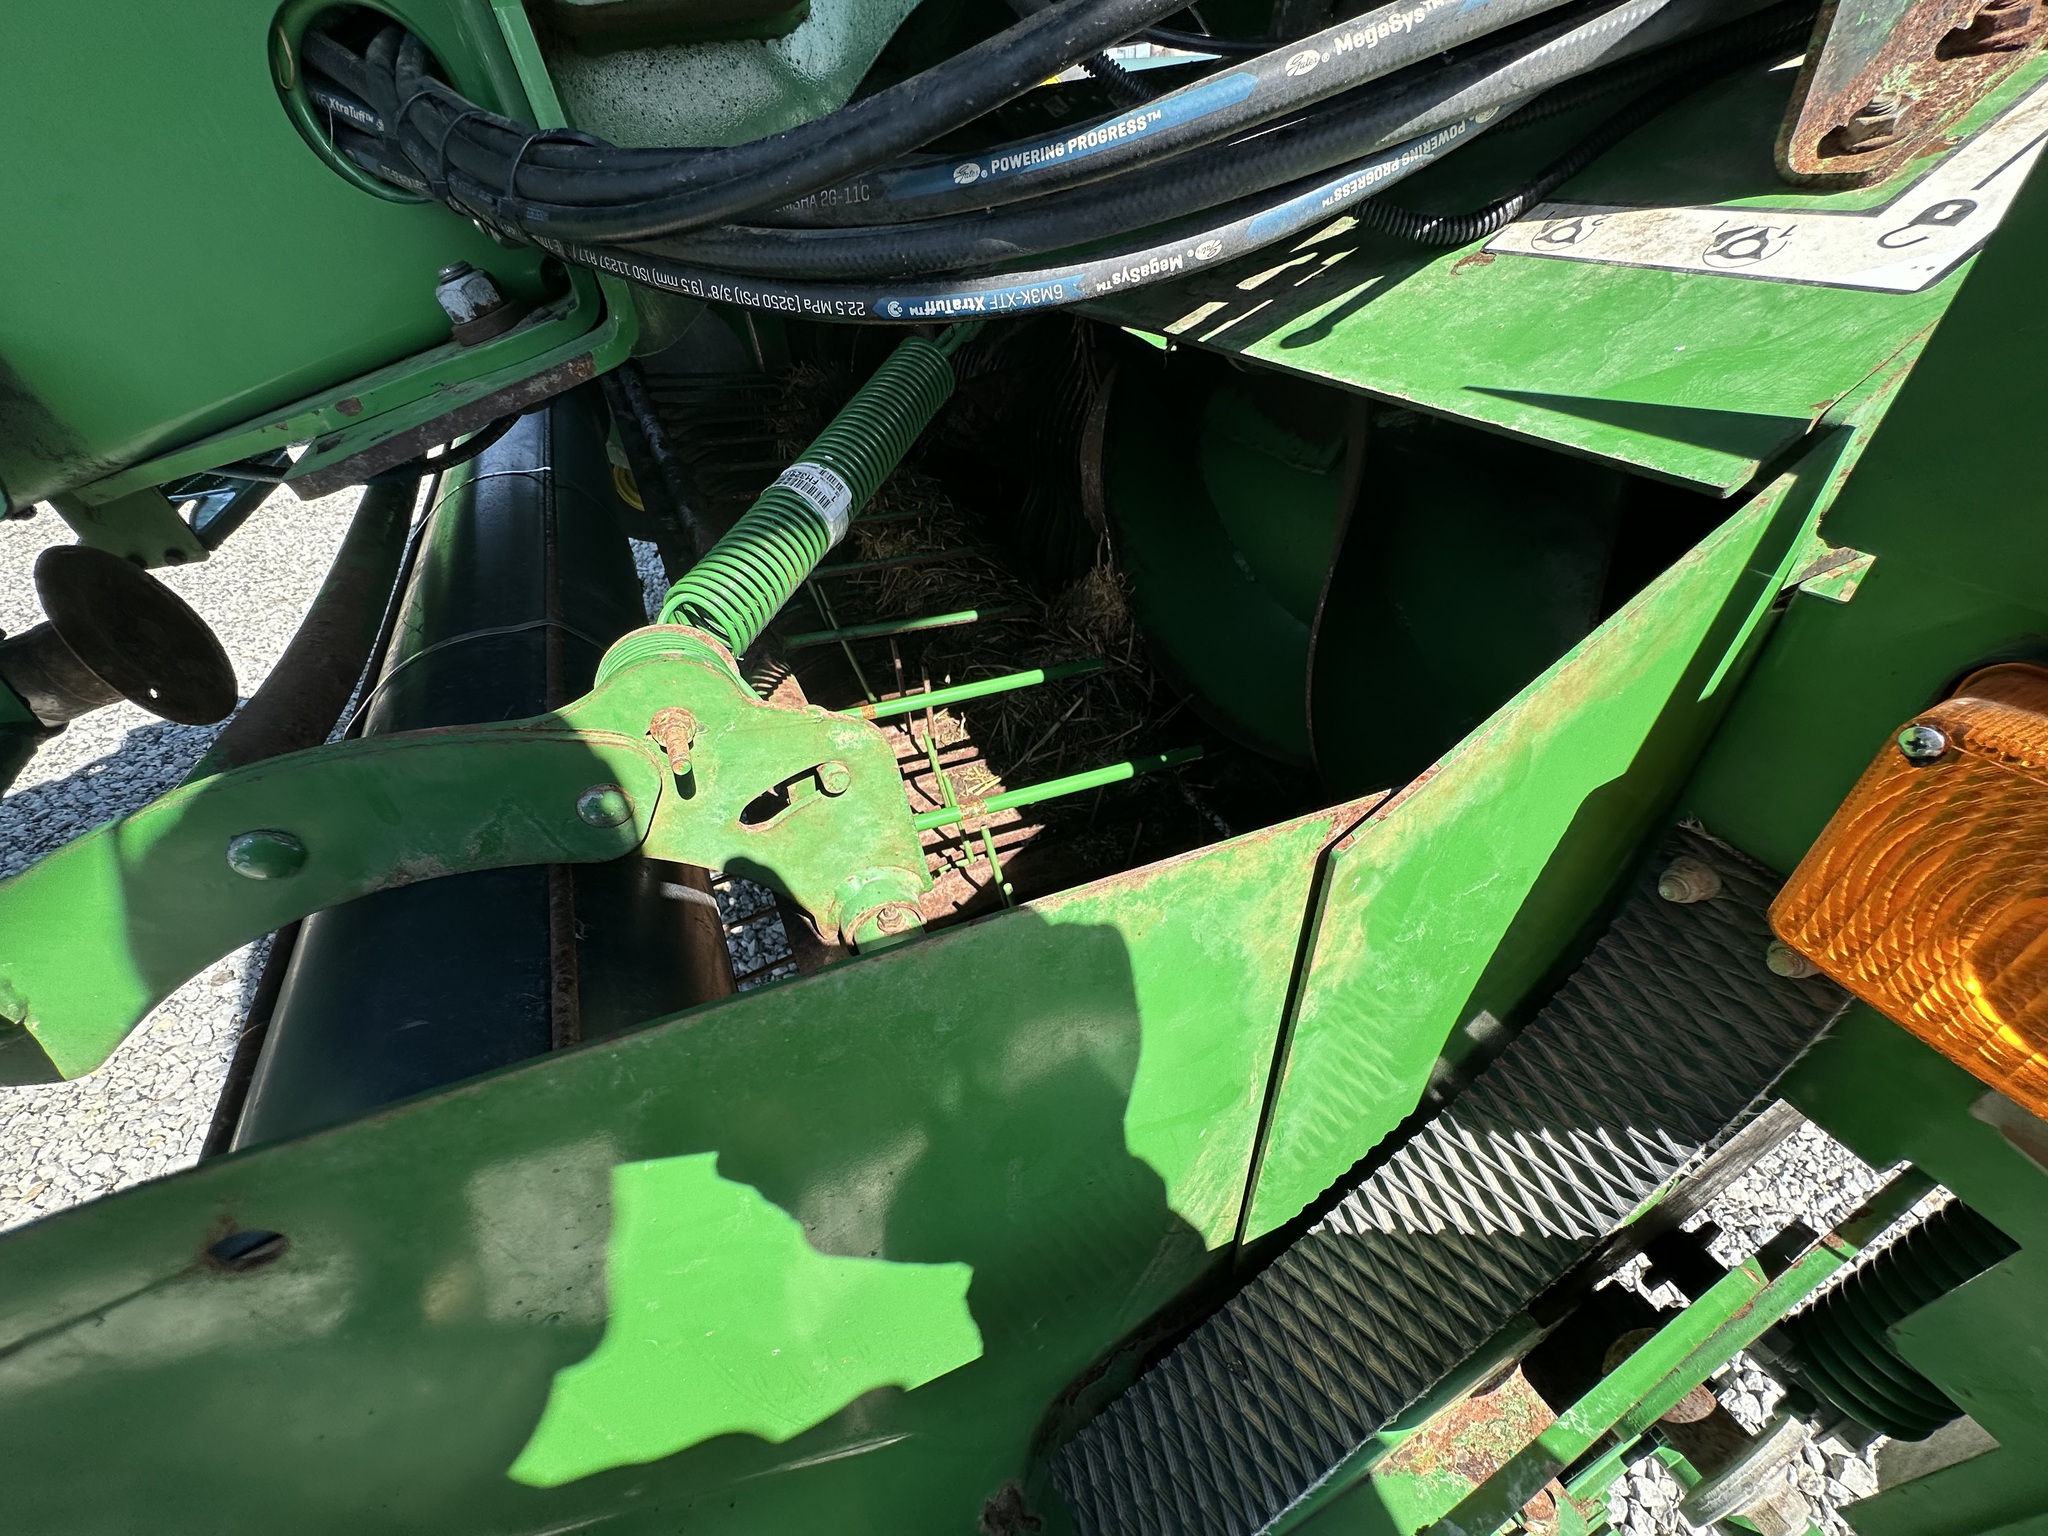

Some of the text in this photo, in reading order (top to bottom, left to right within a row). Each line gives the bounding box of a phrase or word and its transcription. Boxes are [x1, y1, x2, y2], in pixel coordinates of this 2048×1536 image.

[1402, 120, 1466, 167] POWERING
[991, 142, 1065, 174] POWERING
[820, 184, 870, 207] 2G-11C
[579, 248, 598, 266] R17
[600, 255, 631, 276] 11237
[632, 265, 651, 283] ISO
[652, 268, 679, 287] mm)
[681, 278, 705, 297] (9.5
[708, 283, 733, 302] 3/8"
[735, 286, 761, 307] PSI)
[989, 282, 1064, 312] 6M3K-XTF
[763, 294, 802, 313] (3250
[804, 298, 833, 315] MPa
[836, 301, 866, 316] 22.5
